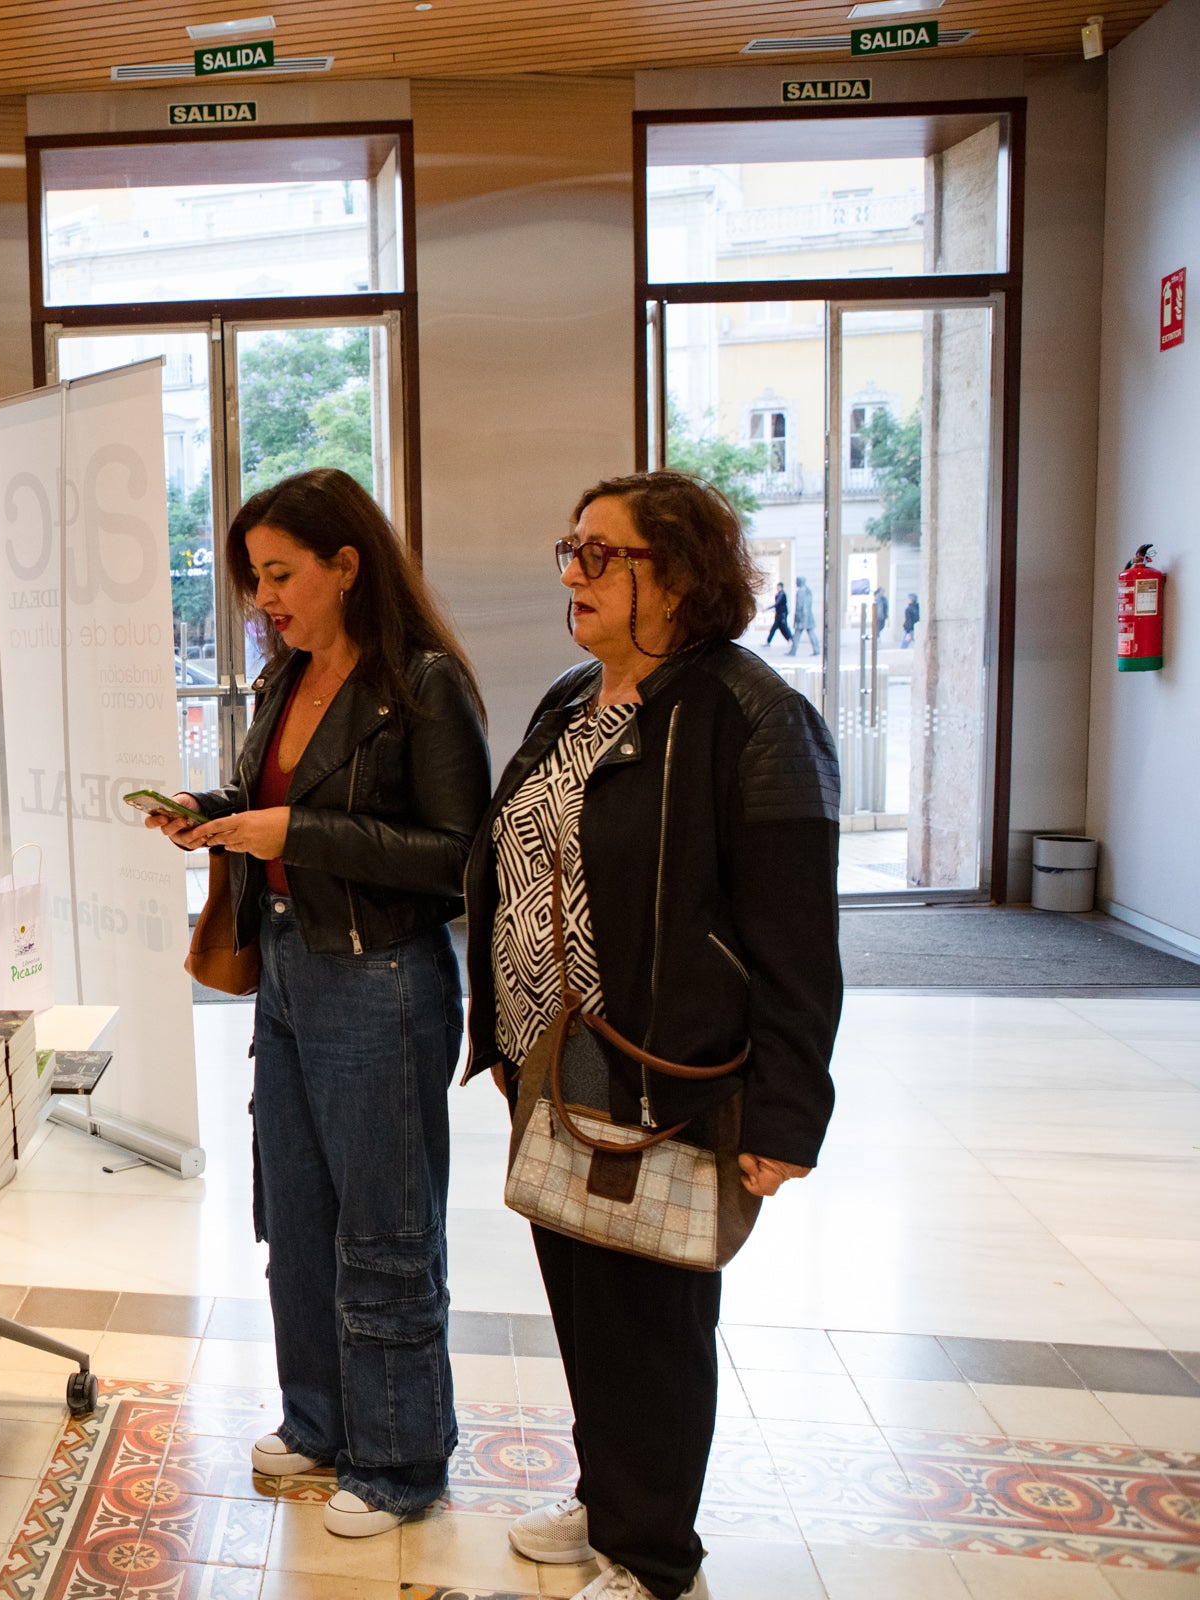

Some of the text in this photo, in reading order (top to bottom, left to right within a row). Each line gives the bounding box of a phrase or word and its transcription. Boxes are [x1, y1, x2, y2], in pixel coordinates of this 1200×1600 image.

[858, 26, 930, 51] SALIDA
[202, 46, 267, 71] SALIDA
[786, 81, 866, 100] SALIDA
[173, 104, 252, 123] SALIDA
[10, 962, 43, 982] Picasso
